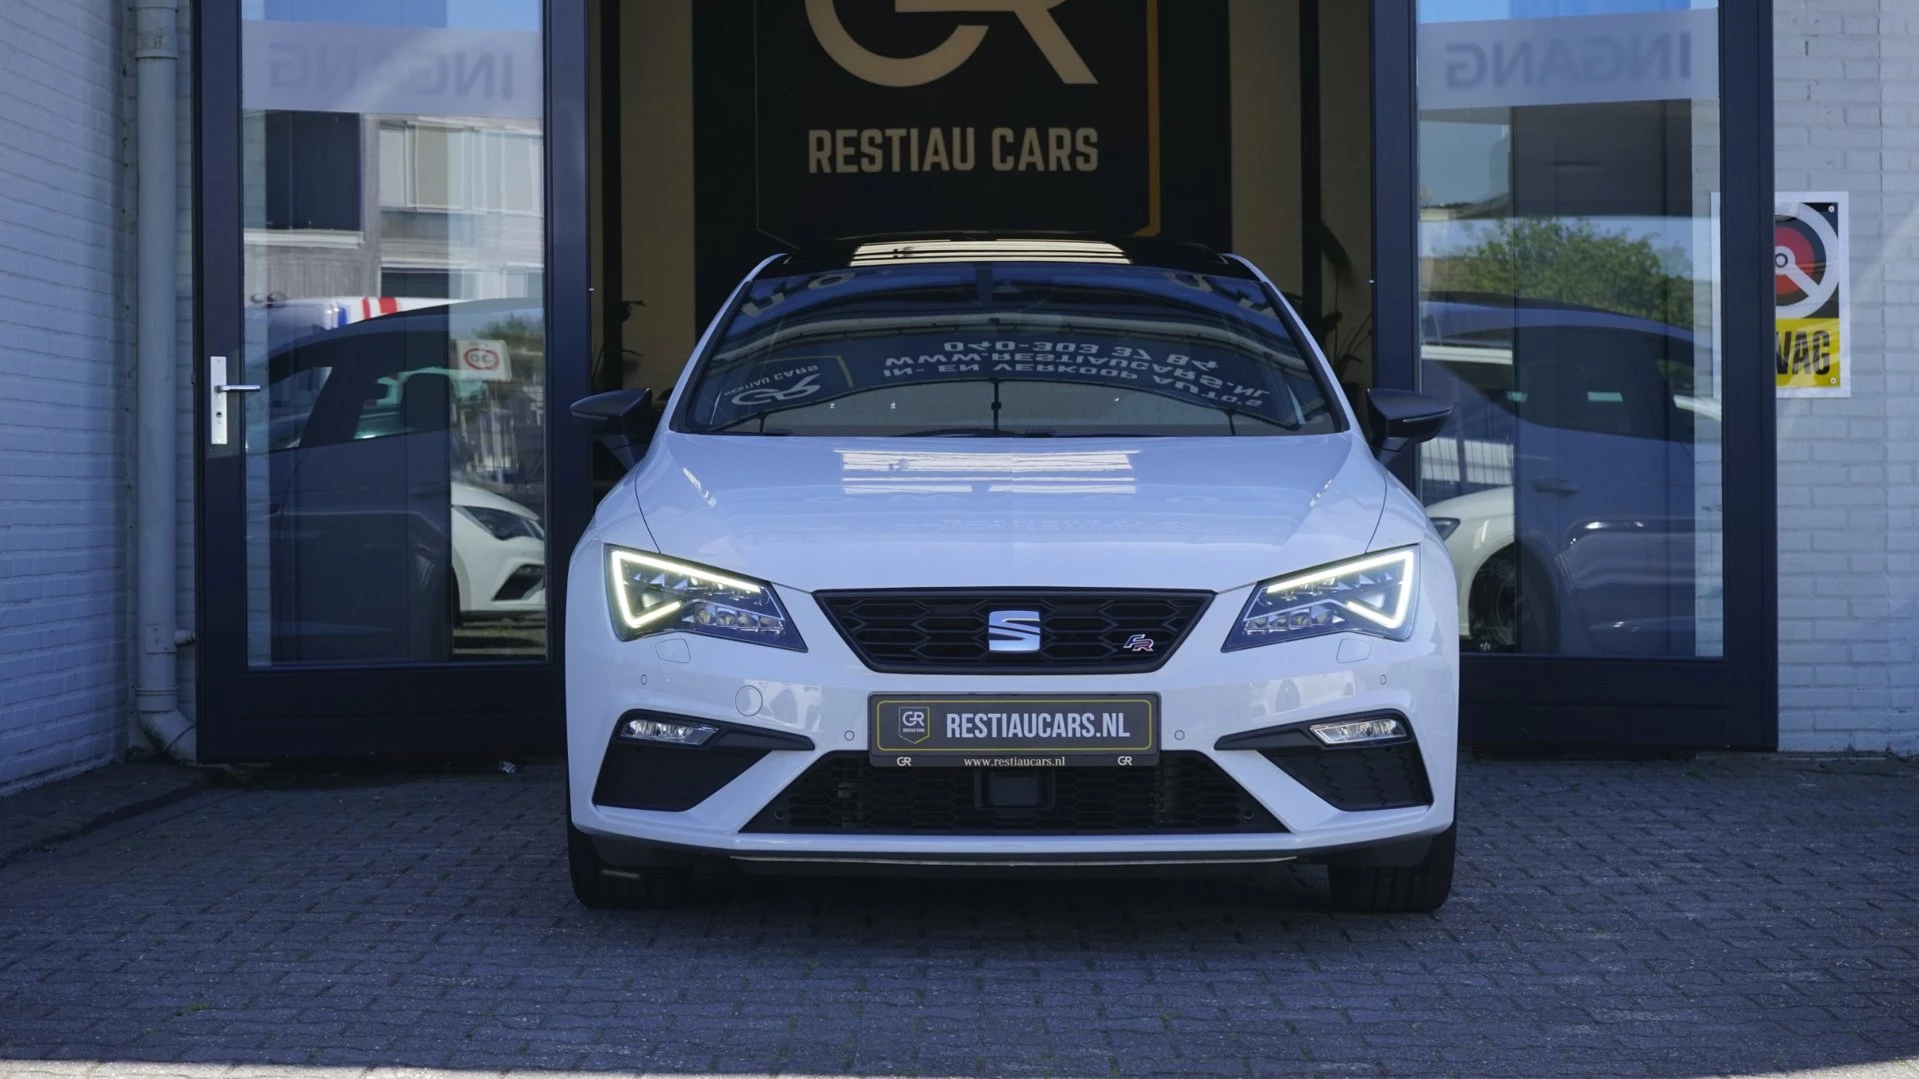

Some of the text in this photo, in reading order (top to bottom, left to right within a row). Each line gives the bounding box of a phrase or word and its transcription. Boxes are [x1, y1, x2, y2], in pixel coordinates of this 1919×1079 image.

[808, 127, 1099, 174] RESTIAU CARS
[1775, 330, 1830, 375] VAG
[1123, 634, 1154, 651] FR
[946, 712, 1131, 738] RESTIAUCARS.NL
[896, 756, 912, 767] GR
[963, 756, 1066, 767] www.restiaucars.nl
[1117, 755, 1133, 766] GR
